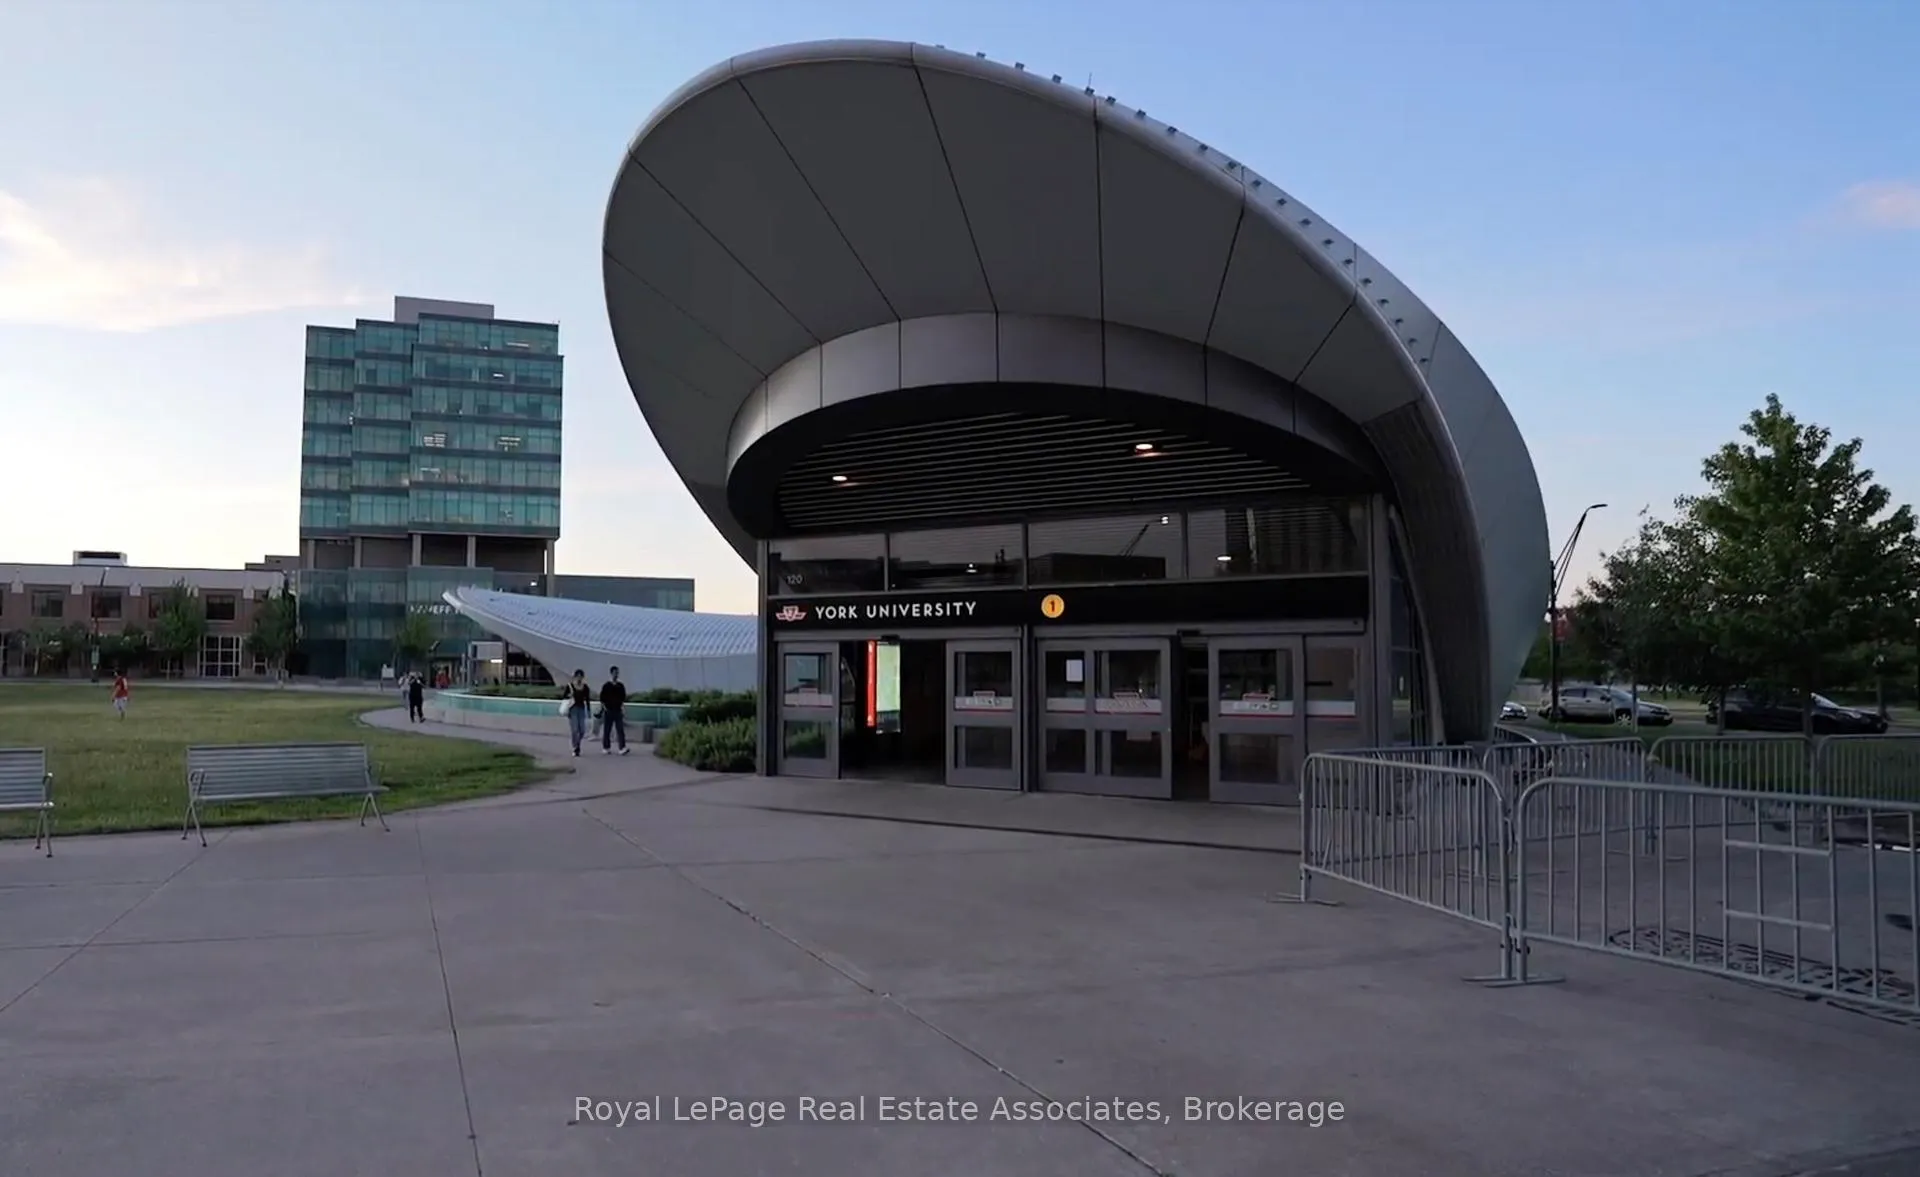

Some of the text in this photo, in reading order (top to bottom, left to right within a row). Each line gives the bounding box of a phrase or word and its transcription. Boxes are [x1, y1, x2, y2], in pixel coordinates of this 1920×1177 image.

[786, 574, 803, 585] 120
[815, 605, 858, 620] YORK
[866, 602, 977, 619] UNIVERSITY
